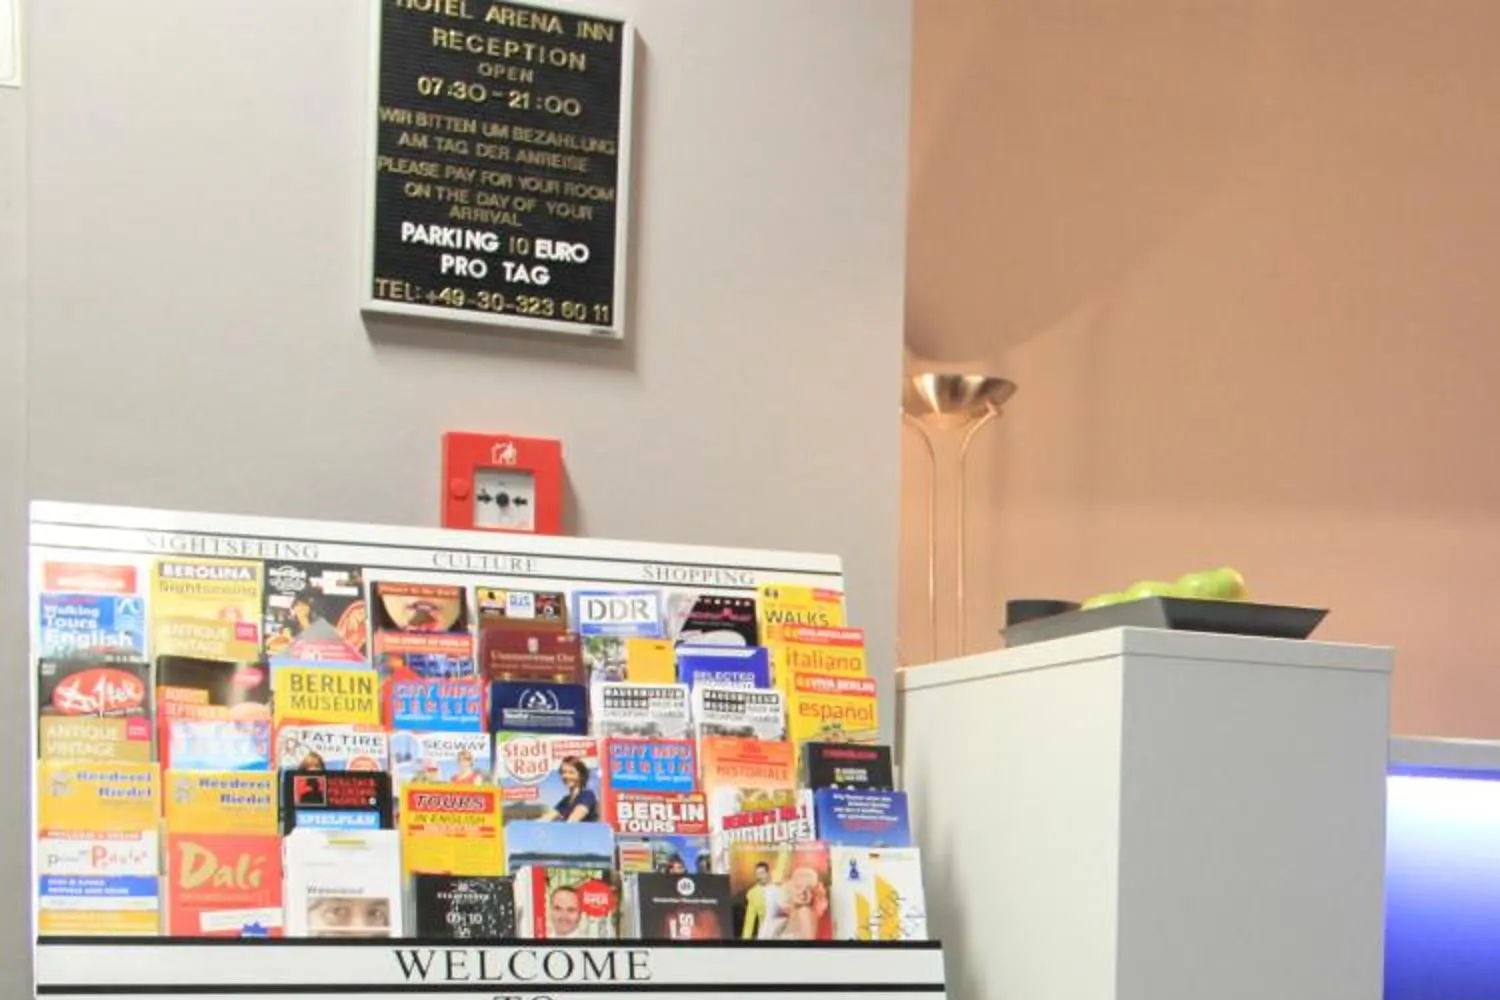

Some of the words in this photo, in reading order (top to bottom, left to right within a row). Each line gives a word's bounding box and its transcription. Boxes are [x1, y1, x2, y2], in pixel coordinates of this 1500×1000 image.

[485, 4, 564, 34] ARENA
[577, 21, 614, 42] INN
[432, 27, 587, 71] RECEPTION
[478, 62, 535, 83] OPEN
[378, 106, 413, 124] WIR
[415, 111, 477, 134] BITTEN
[482, 123, 508, 139] UM
[512, 126, 615, 154] BEZAHLUNG
[398, 131, 428, 149] AM
[433, 136, 468, 155] TAG
[475, 143, 510, 160] DER
[515, 149, 591, 173] ANREISE
[377, 156, 439, 178] PLEASE
[445, 165, 477, 182] PAY
[481, 170, 513, 188] FOR
[517, 175, 561, 194] YOUR
[563, 181, 615, 201] ROOM
[403, 182, 431, 199] ON
[437, 185, 470, 204] THE
[476, 191, 510, 209] DAY
[513, 196, 537, 212] OF
[546, 200, 595, 220] YOUR
[448, 205, 523, 227] ARRIVAL
[400, 221, 500, 253] PARKING
[509, 236, 529, 256] 10
[535, 238, 590, 263] EURO
[440, 254, 488, 279] PRO
[502, 261, 551, 286] TAG
[594, 304, 609, 323] 11
[146, 534, 320, 559] SIGHTSEEING
[162, 563, 252, 581] BEROLINA
[432, 552, 538, 573] CULTURE
[643, 565, 756, 585] SHOPPING
[44, 604, 101, 618] Walking
[587, 598, 651, 620] DDR
[764, 609, 829, 628] WALKS
[46, 618, 98, 630] Tours
[44, 629, 134, 650] English
[785, 647, 862, 672] italiano
[290, 673, 373, 695] BERLIN
[290, 694, 374, 712] MUSEUM
[800, 701, 874, 722] español
[422, 739, 486, 751] SEGWAY
[514, 758, 549, 774] Rad
[220, 793, 271, 805] Riedel
[616, 801, 706, 822] BERLIN
[618, 820, 675, 833] TOURS
[176, 841, 267, 891] Dalí
[392, 949, 653, 981] WELCOME
